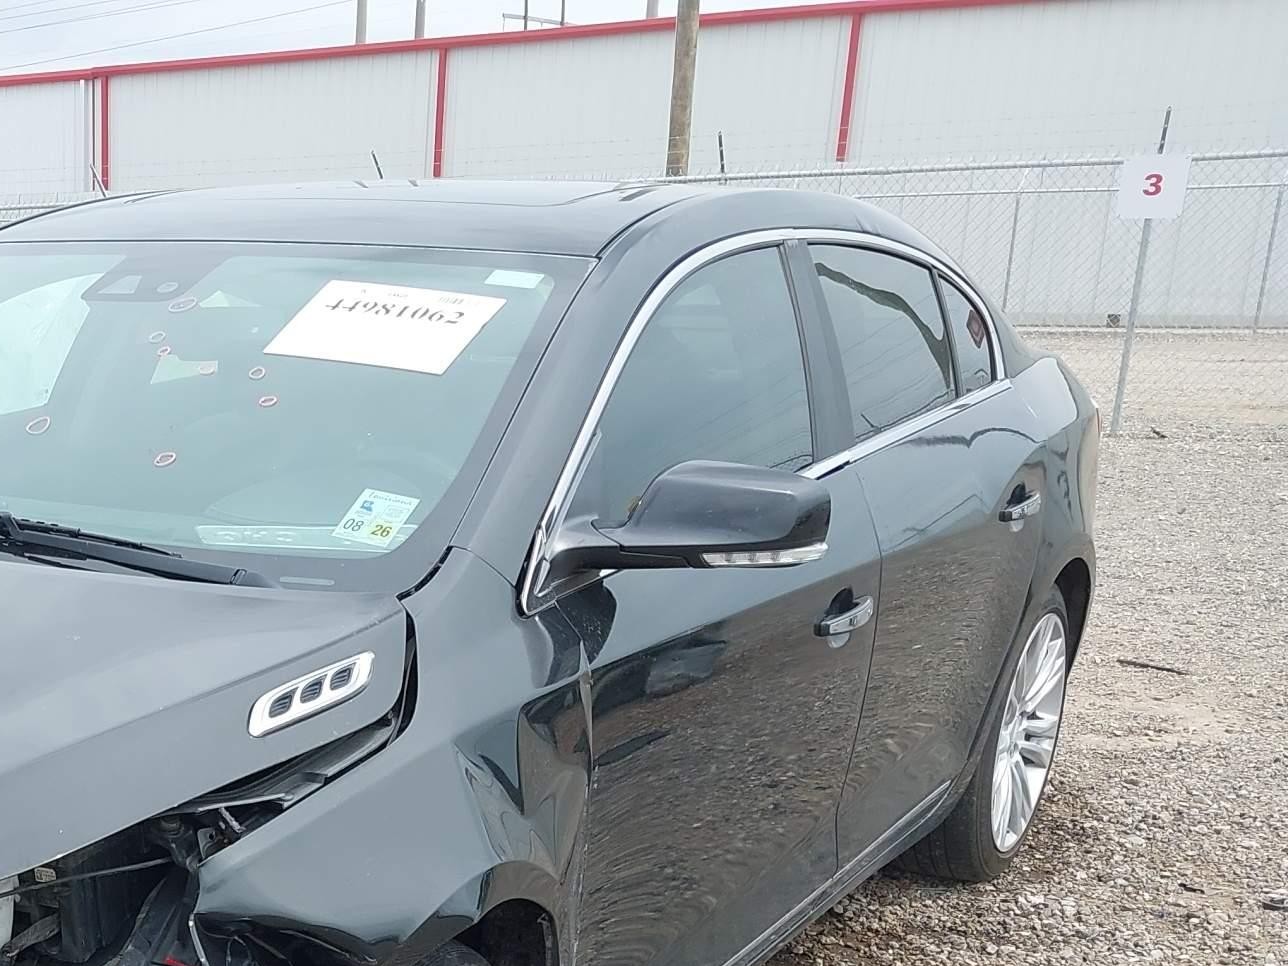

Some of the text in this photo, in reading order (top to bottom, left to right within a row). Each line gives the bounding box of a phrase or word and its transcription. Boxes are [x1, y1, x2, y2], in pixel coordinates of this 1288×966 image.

[1142, 173, 1164, 196] 3
[326, 298, 464, 324] 44981062
[343, 518, 392, 538] 08 26
